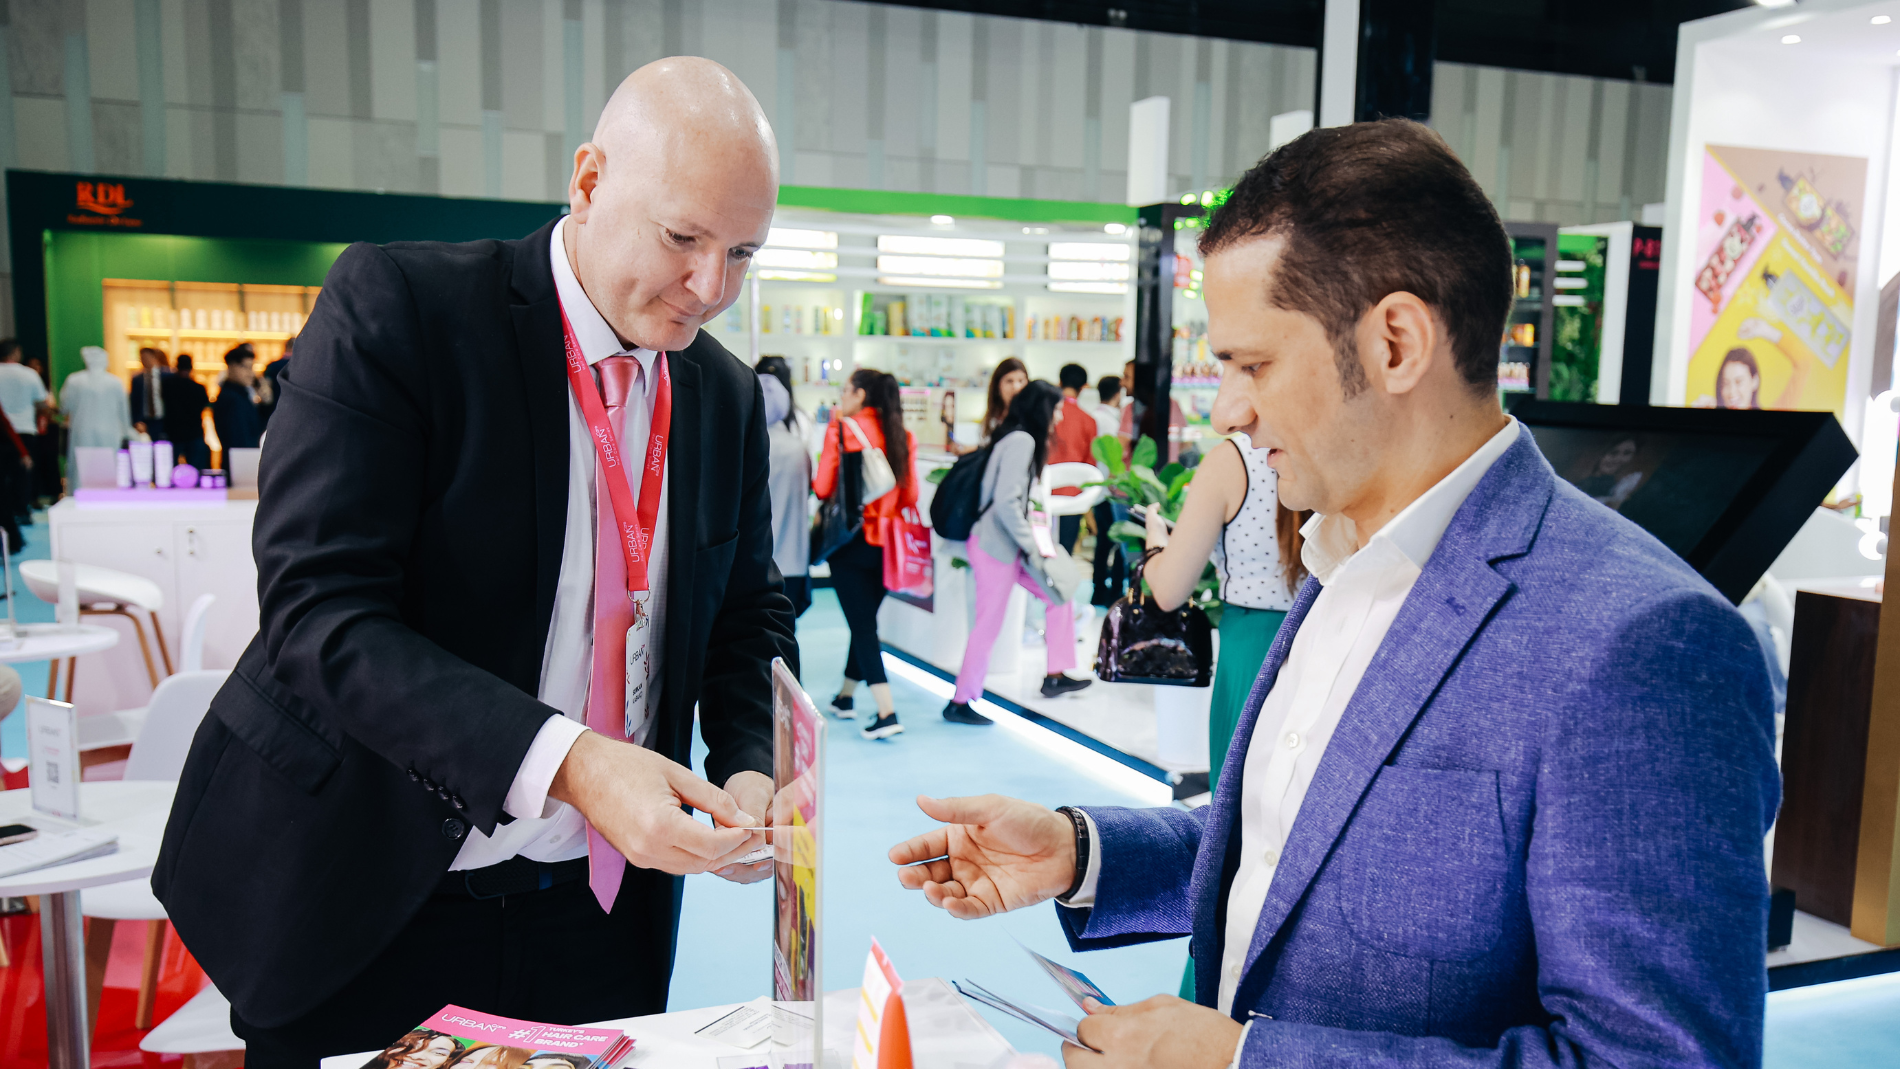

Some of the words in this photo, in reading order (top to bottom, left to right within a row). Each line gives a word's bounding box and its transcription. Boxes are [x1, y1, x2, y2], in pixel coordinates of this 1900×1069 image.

[598, 428, 617, 468] URBAN
[651, 435, 664, 471] URBAN
[626, 525, 640, 562] URBAN
[441, 1013, 498, 1033] URBAN
[542, 1031, 573, 1040] HAIR
[574, 1033, 609, 1042] CARE
[549, 1026, 585, 1034] TURKEY'S
